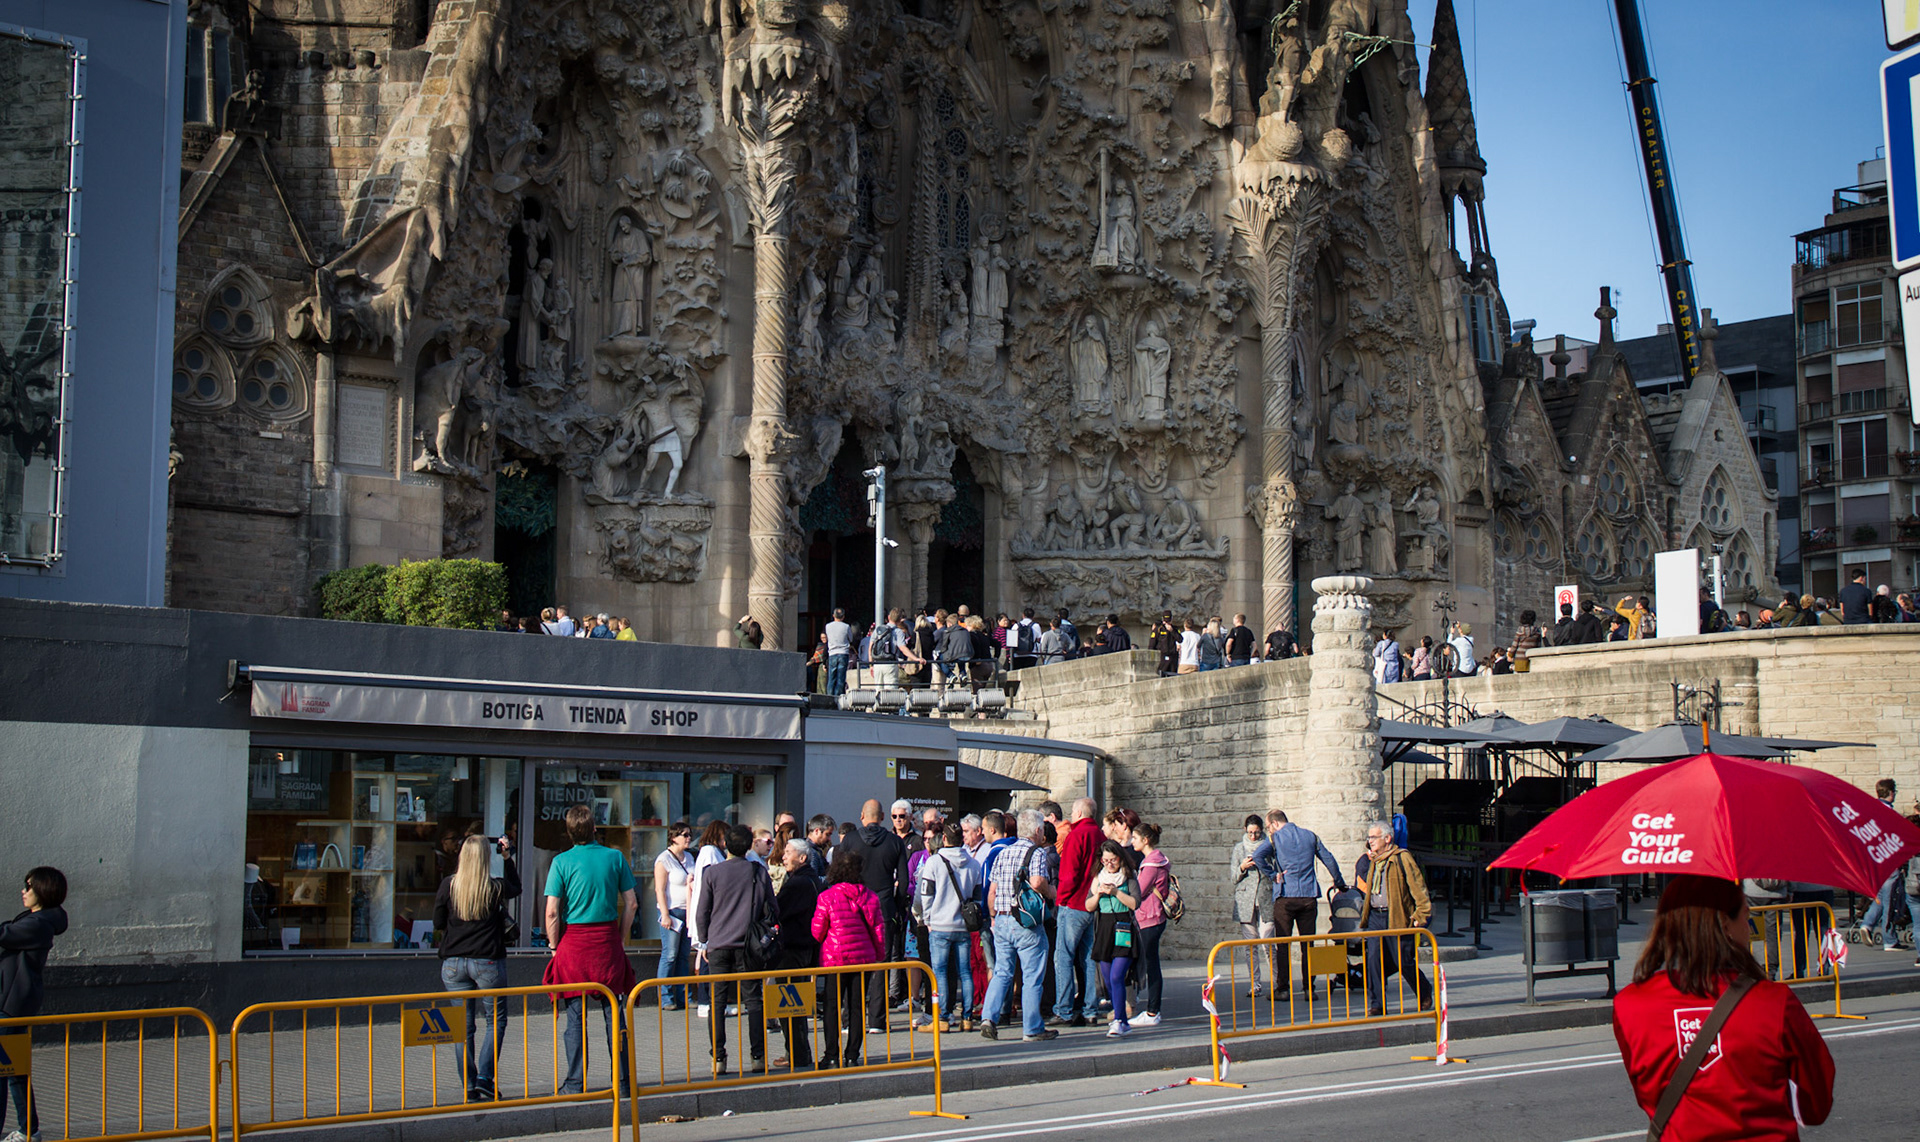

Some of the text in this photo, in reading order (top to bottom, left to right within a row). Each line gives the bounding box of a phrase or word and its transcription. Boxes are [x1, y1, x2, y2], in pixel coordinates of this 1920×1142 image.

[1642, 107, 1665, 188] CABALLER
[1676, 290, 1700, 376] CABALLE
[482, 702, 699, 727] BOTIGA TIENDA SHOP
[281, 781, 322, 792] SAGRADA
[541, 787, 596, 802] TIENDA
[1832, 800, 1860, 824] Get
[1632, 813, 1675, 830] Get
[1628, 831, 1685, 848] Your
[1849, 818, 1882, 845] Your
[1621, 847, 1694, 865] Guide
[1867, 833, 1904, 864] Guide
[1680, 1018, 1702, 1031] Get
[1681, 1031, 1697, 1043] Yo
